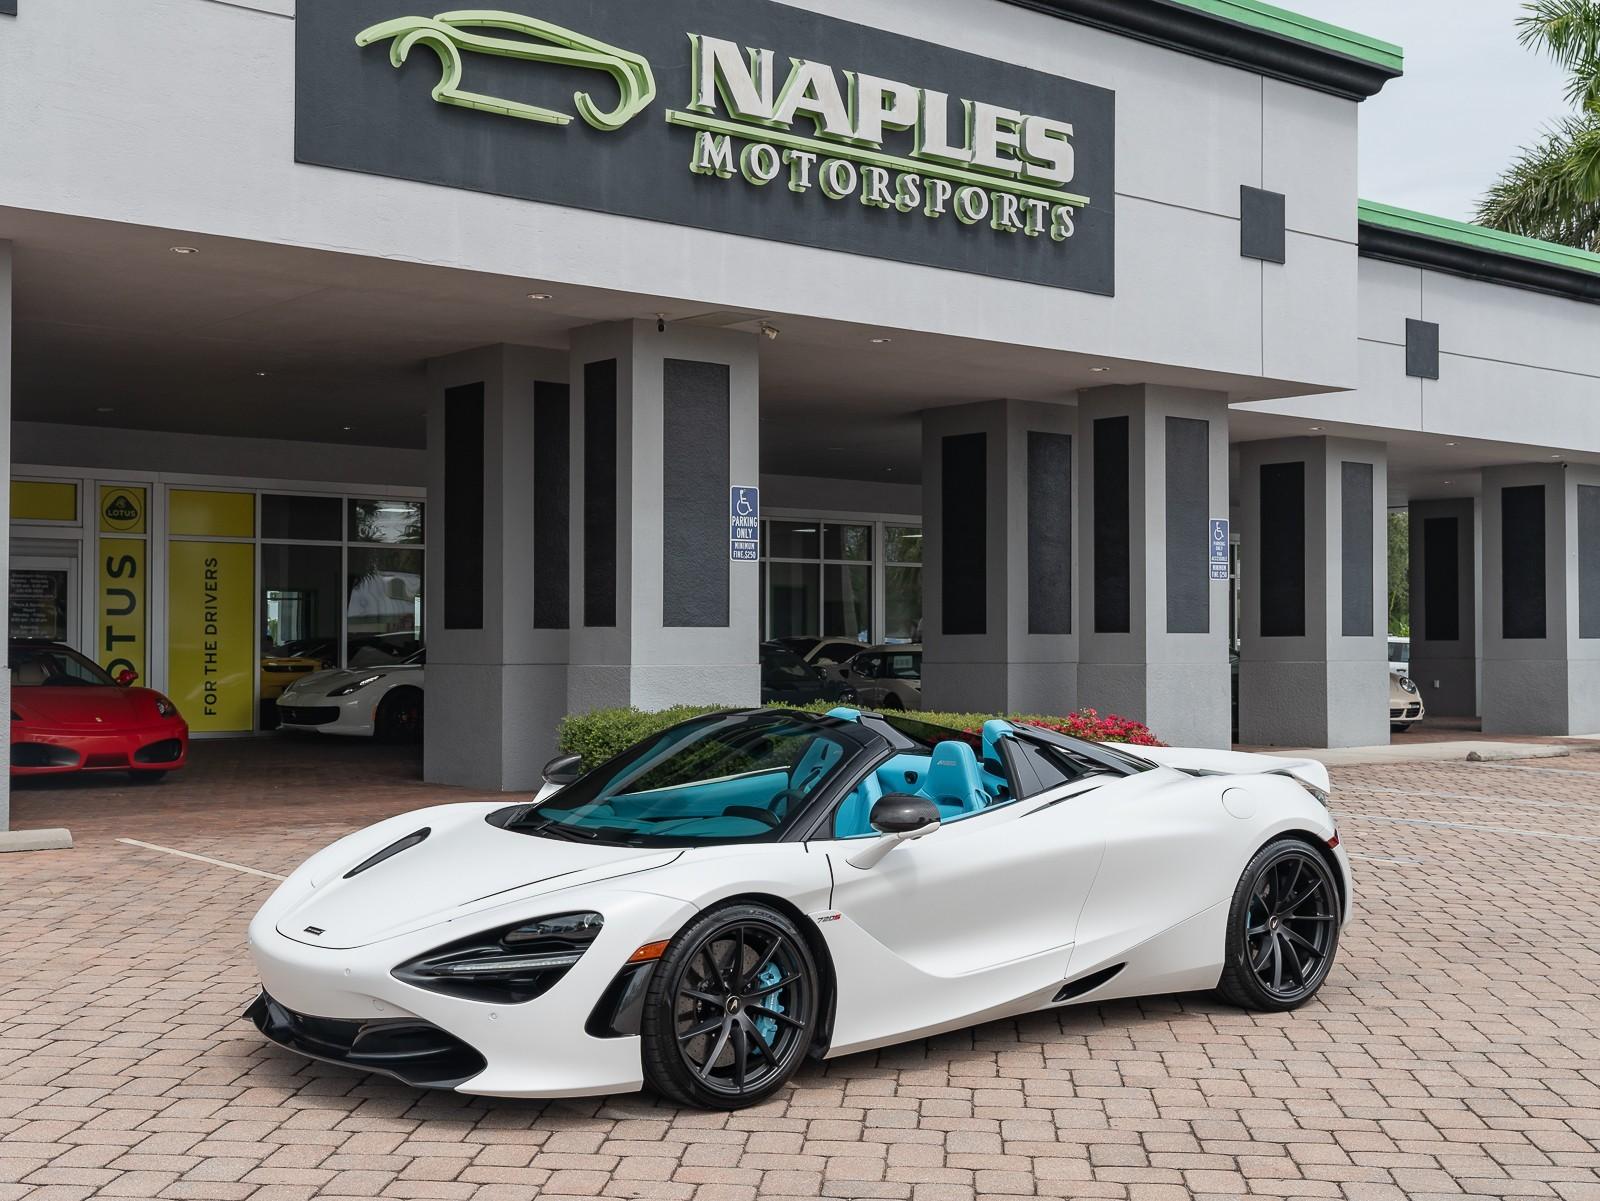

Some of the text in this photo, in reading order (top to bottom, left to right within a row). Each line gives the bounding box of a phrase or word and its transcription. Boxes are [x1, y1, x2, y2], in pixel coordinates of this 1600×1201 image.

[687, 33, 1075, 187] NAPLES
[689, 131, 1077, 241] MOTORSPORTS
[732, 516, 758, 527] PARKING
[737, 528, 753, 539] ONLY
[106, 554, 137, 689] OTUS
[204, 557, 218, 716] FOR THE DRIVERS
